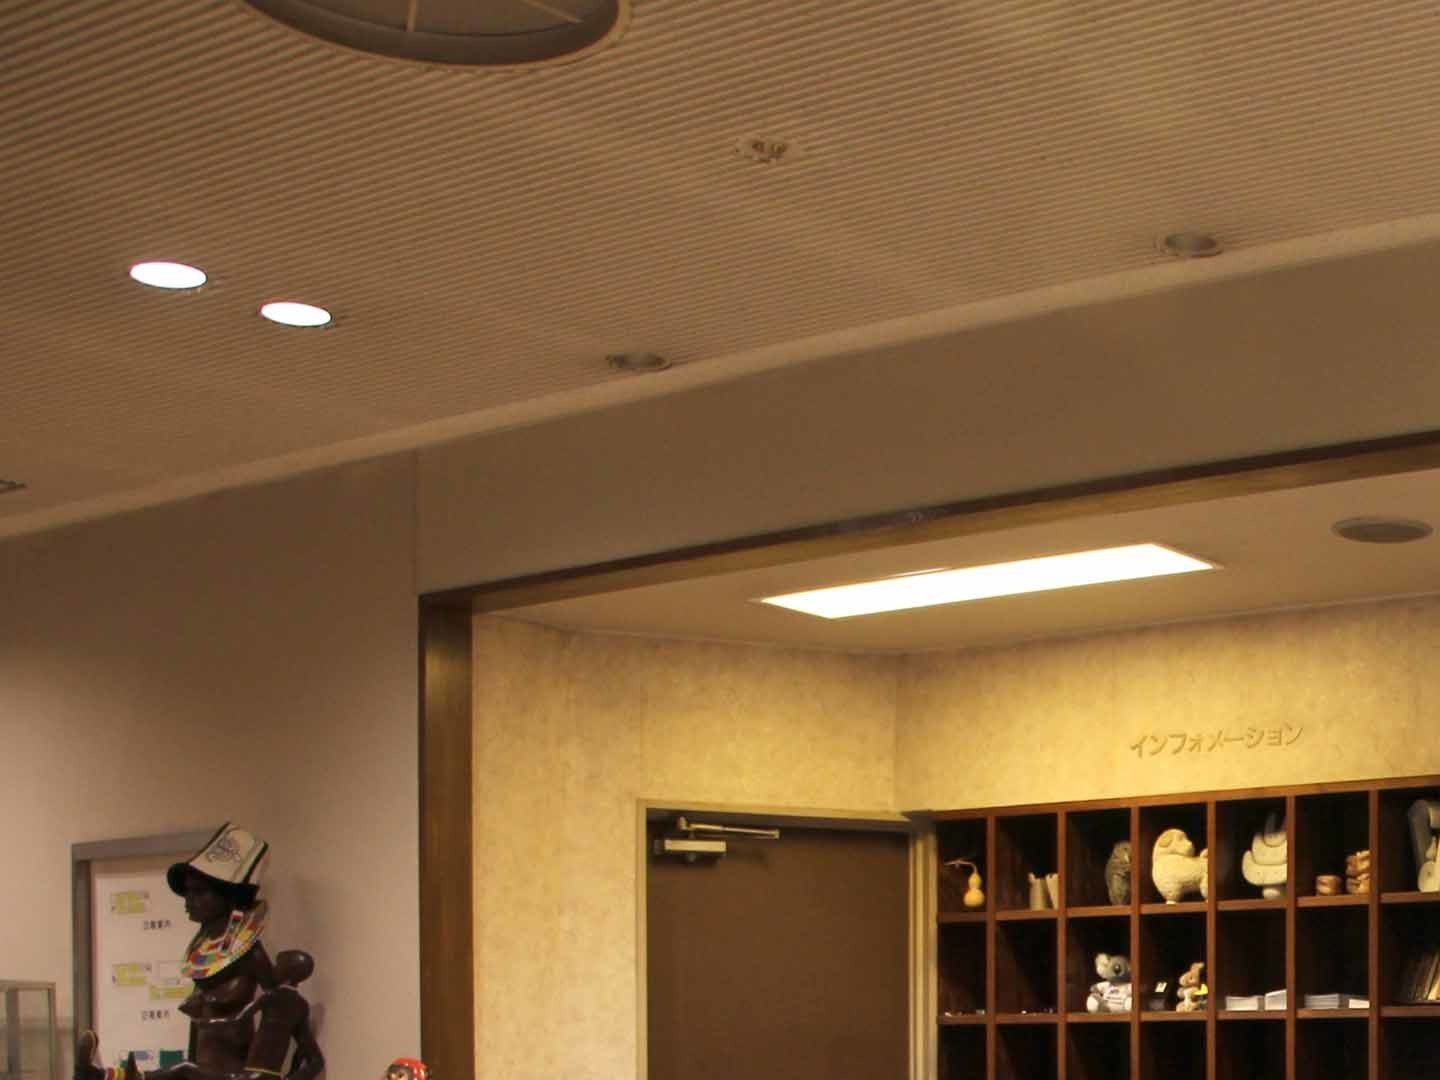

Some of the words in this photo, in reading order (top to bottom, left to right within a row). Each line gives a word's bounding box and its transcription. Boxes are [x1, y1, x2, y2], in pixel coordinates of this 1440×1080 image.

[1130, 722, 1304, 758] インフォメーション
